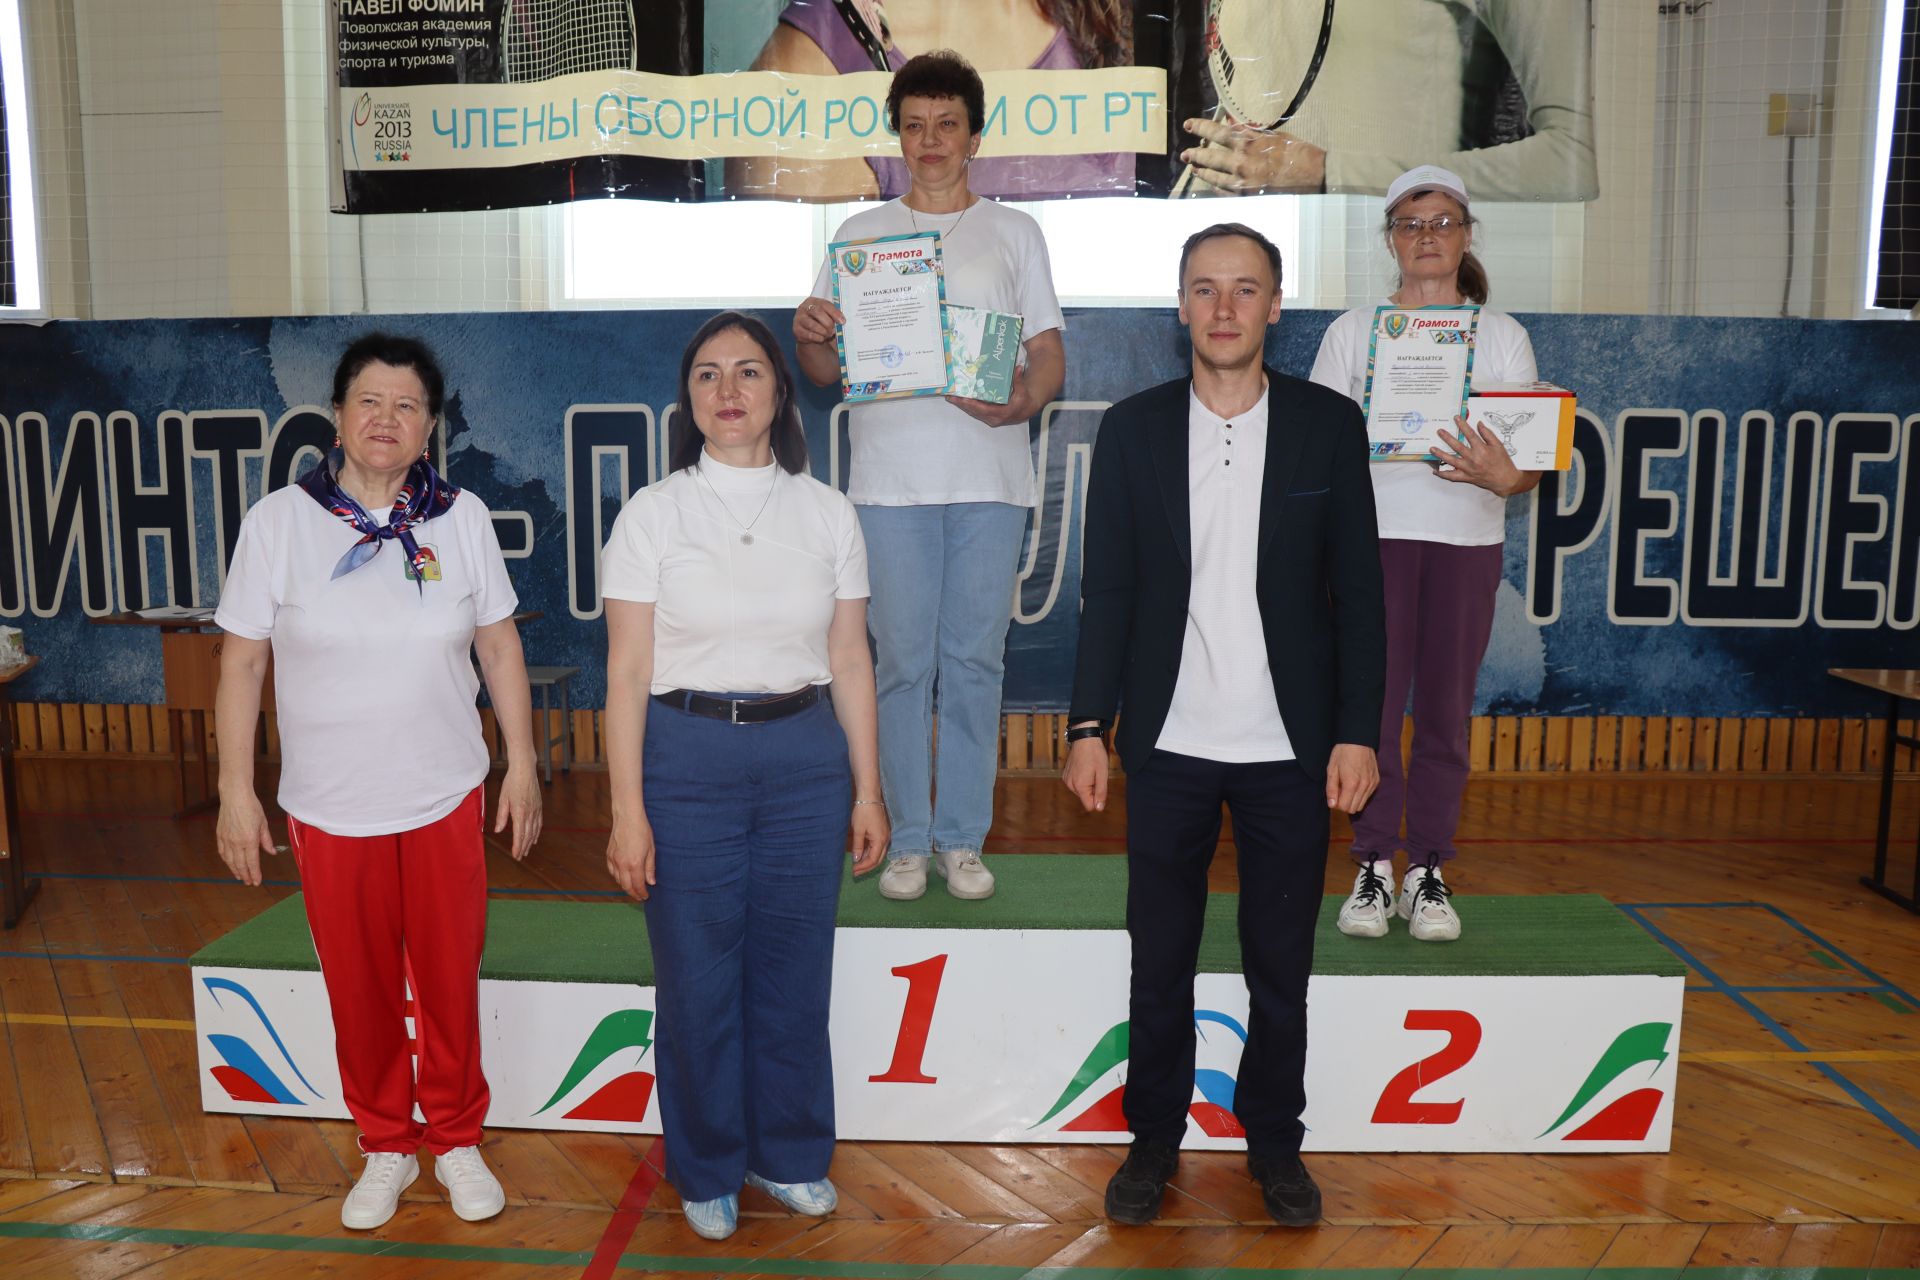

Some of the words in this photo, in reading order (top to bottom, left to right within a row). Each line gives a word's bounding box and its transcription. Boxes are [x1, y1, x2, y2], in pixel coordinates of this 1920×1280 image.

[339, 0, 403, 15] ПАВЕЛ
[408, 0, 484, 12] ФОМИН
[339, 21, 419, 34] Поволжская
[422, 19, 492, 31] академия
[338, 36, 418, 53] физической
[421, 36, 490, 50] культуры,
[338, 57, 386, 70] спорта
[389, 58, 397, 67] и
[400, 54, 455, 68] туризма
[374, 109, 411, 119] KAZAN
[432, 97, 578, 149] ЧЛЕНЫ
[594, 88, 807, 140] СБОРНОЙ
[1024, 93, 1087, 136] ОТ
[1104, 91, 1157, 133] РТ
[374, 121, 412, 138] 2013
[374, 140, 412, 151] RUSSIA
[872, 248, 923, 263] Грамота
[1412, 318, 1460, 329] Грамота
[992, 320, 1008, 361] Alpenkok
[1525, 407, 1920, 631] РЕШЕ
[867, 953, 949, 1085] 1
[1370, 1008, 1483, 1126] 2
